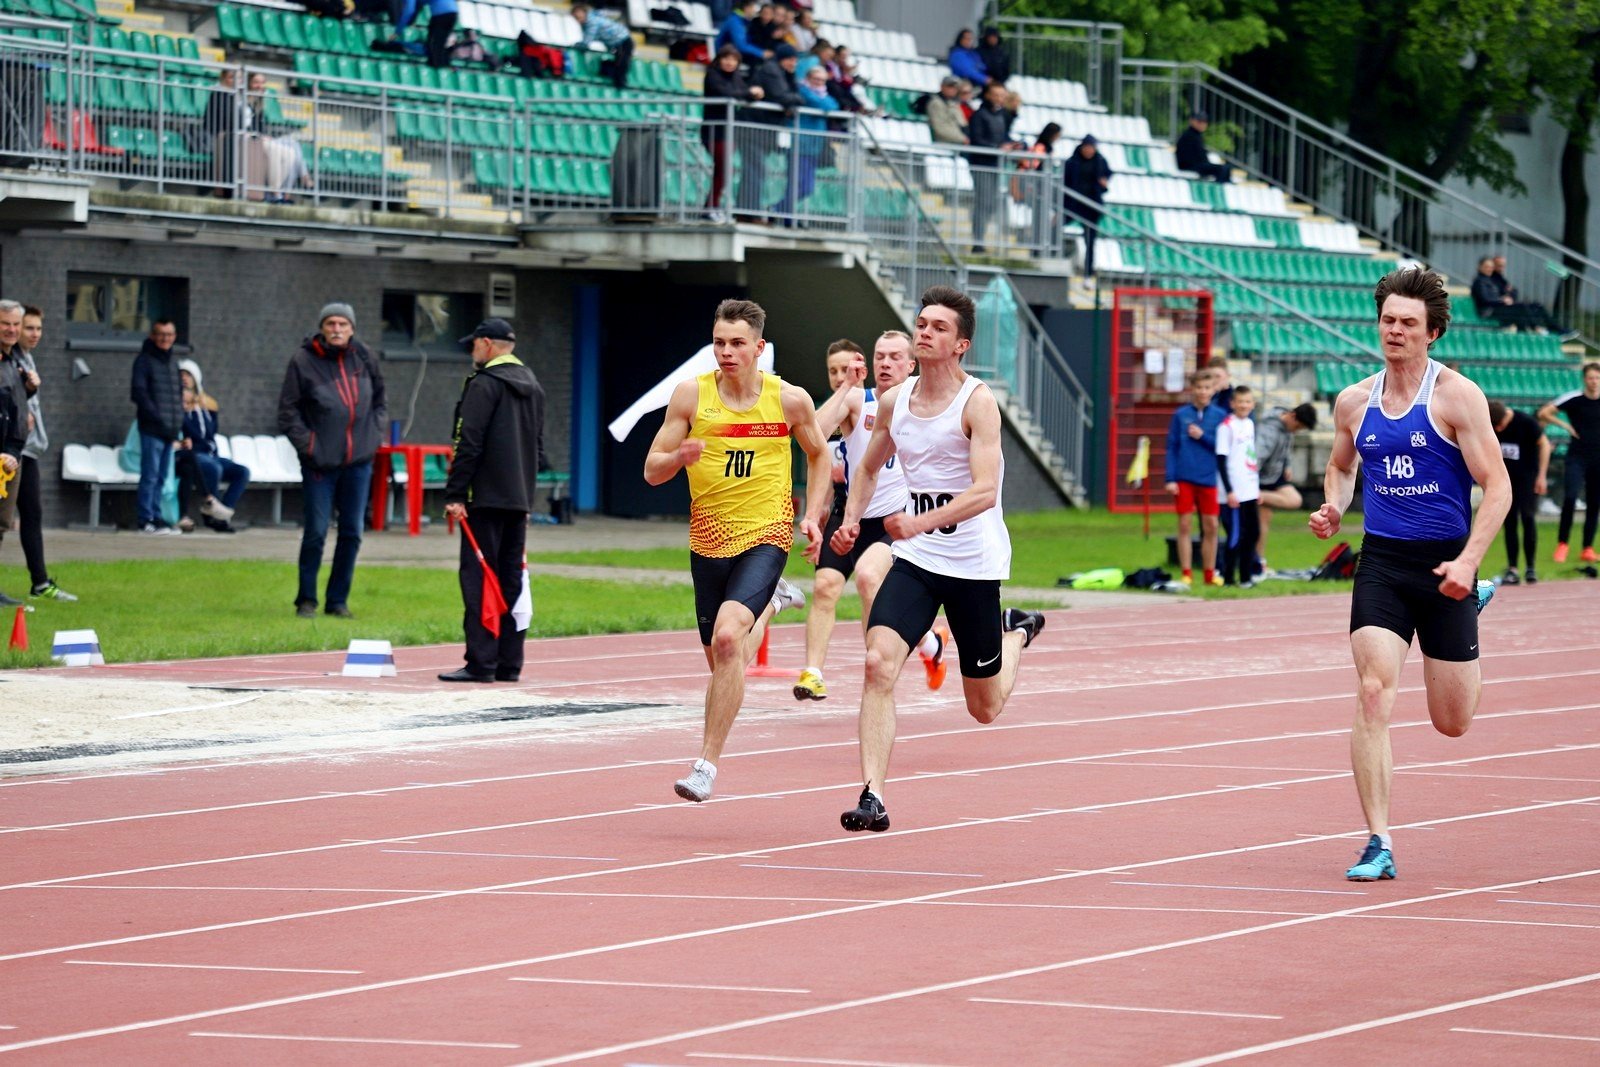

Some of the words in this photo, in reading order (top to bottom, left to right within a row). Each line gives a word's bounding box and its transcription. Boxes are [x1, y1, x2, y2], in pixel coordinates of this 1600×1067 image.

[724, 450, 755, 478] 707
[1382, 455, 1415, 479] 148
[1390, 481, 1440, 497] POZNAŃ
